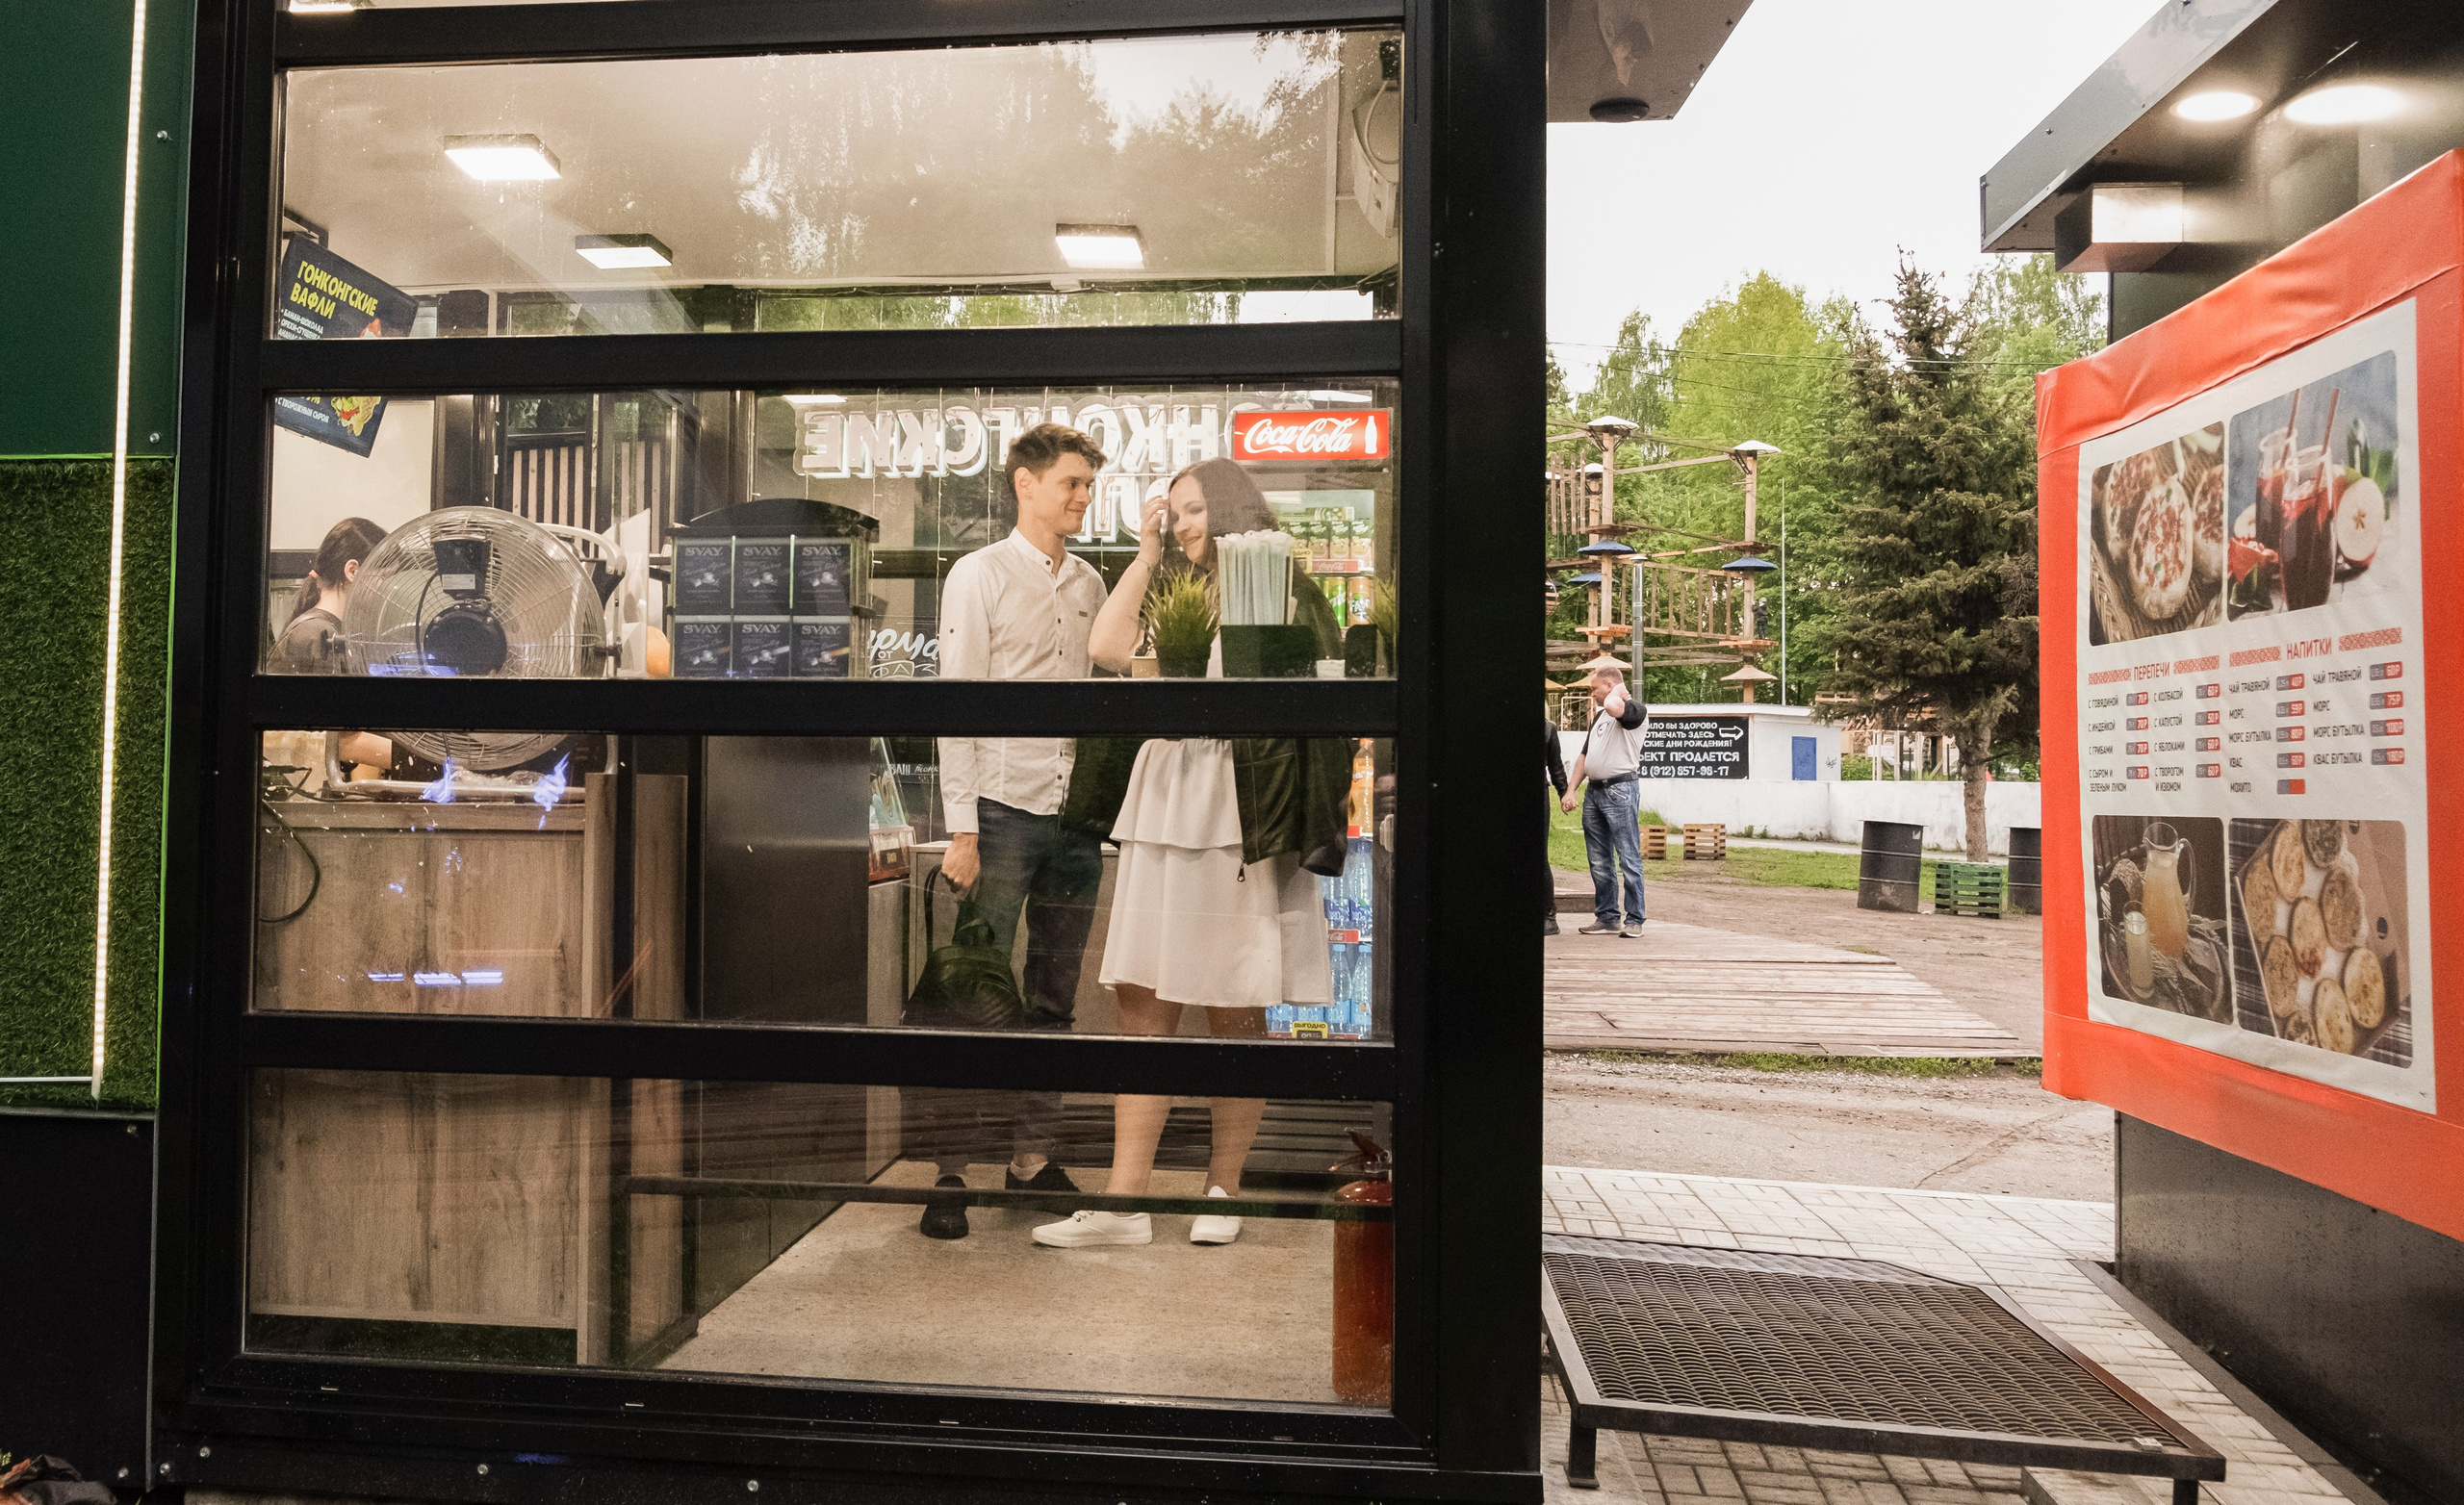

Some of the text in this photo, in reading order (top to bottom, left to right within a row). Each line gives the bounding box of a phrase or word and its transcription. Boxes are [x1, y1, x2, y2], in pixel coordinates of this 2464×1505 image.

[297, 261, 378, 317] ГОНКОНГСКИЕ
[291, 283, 336, 319] ВАФЛИ
[1244, 418, 1359, 453] Coca-Cola
[685, 547, 722, 556] SVAY
[743, 547, 782, 556] SVAY
[803, 547, 840, 556] SVAY
[683, 625, 721, 634] SVAY
[742, 625, 781, 633] SVAY
[802, 625, 840, 634] SVAY
[2287, 637, 2331, 659] НАПИТКИ
[2134, 662, 2169, 681] ПЕРЕПЕЧИ
[2313, 671, 2325, 684] ЧАЙ
[2328, 666, 2361, 683] ТРАВЯНОЙ
[2229, 681, 2240, 693] ЧАЙ
[2242, 677, 2270, 692] ТРАВЯНОЙ
[2158, 688, 2183, 701] КОЛБАСОЙ
[2092, 695, 2118, 708] ГОВЯДИНОЙ
[2313, 701, 2330, 712] МОРС
[2229, 708, 2244, 719] МОРС
[2092, 720, 2116, 731] ИНДЕЙКОЙ
[2159, 714, 2182, 727] КАПУСТОЙ
[2313, 727, 2330, 737] МОРС
[2333, 724, 2365, 736] БУТЫЛКА
[2229, 732, 2244, 743] МОРС
[2246, 730, 2272, 742] БУТЫЛКА
[1684, 739, 1732, 748] РОЖДЕНИЯ!
[2159, 741, 2185, 751] ЯБЛОКАМИ
[2092, 746, 2113, 754] ГРИБАМИ
[1670, 752, 1739, 762] ПРОДАЕТСЯ
[2313, 753, 2329, 764] КВАС
[2331, 752, 2362, 764] БУТЫЛКА
[1641, 766, 1647, 776] 8
[1650, 766, 1675, 778] (912)
[2160, 767, 2184, 777] ТВОРОГОМ
[2160, 782, 2181, 791] ИЗЮМОМ
